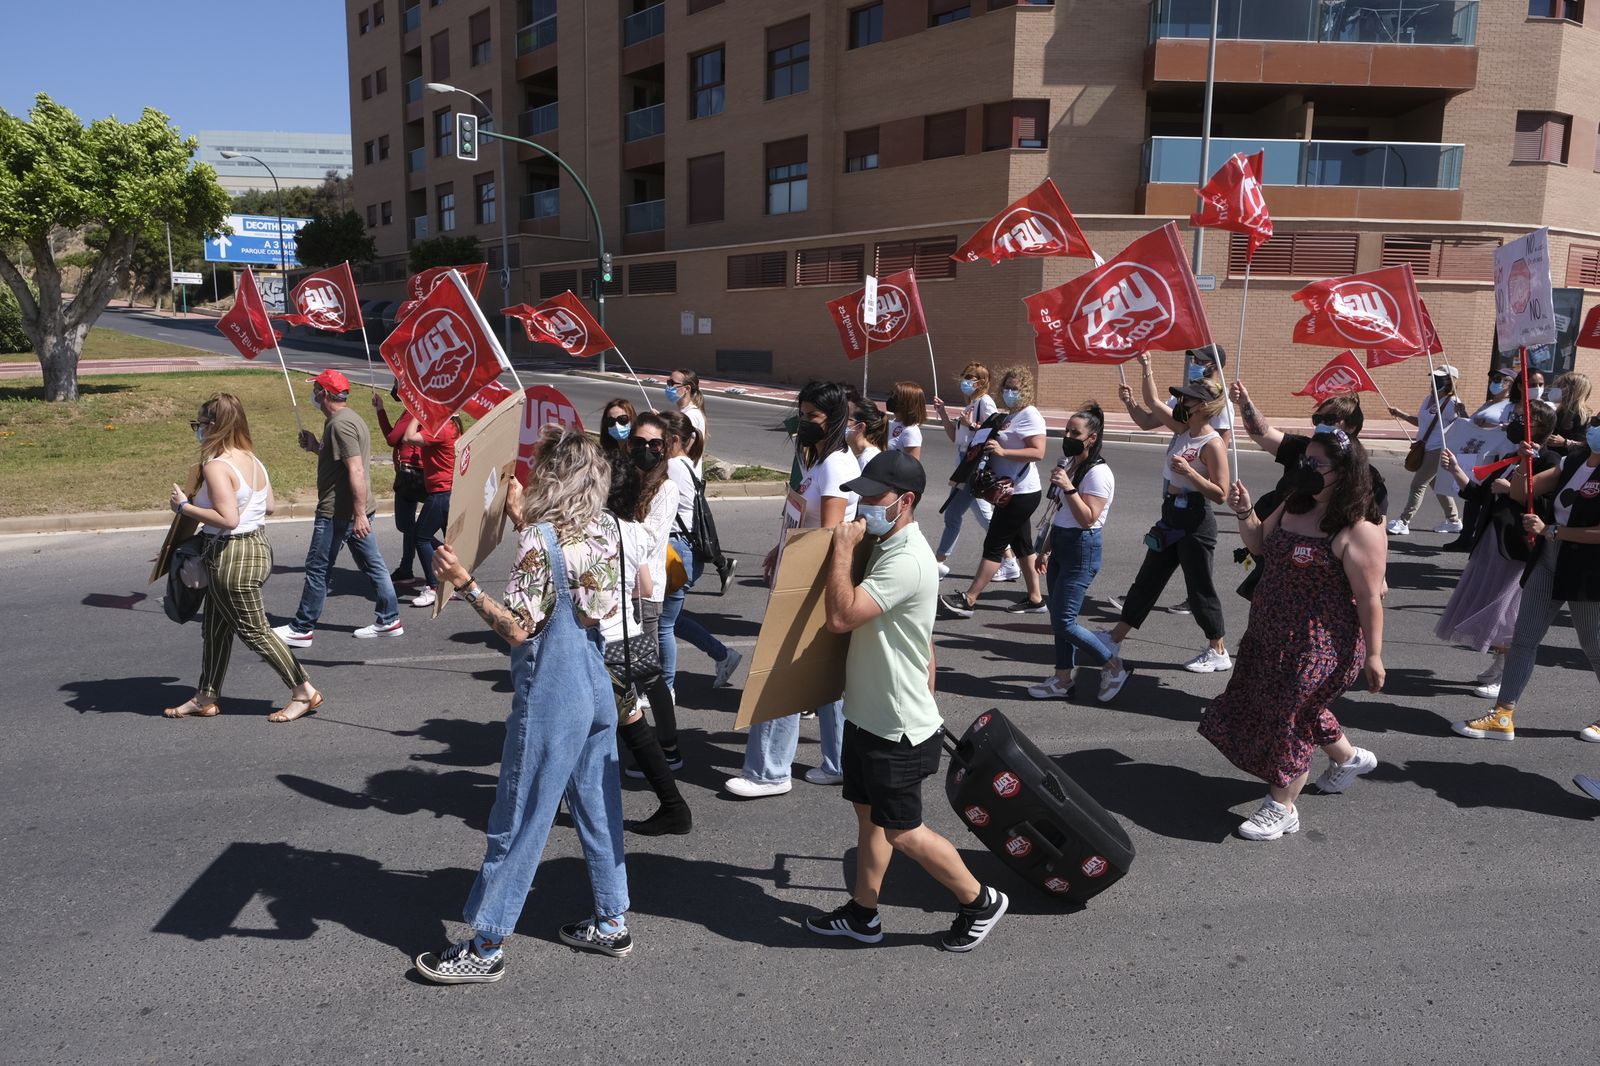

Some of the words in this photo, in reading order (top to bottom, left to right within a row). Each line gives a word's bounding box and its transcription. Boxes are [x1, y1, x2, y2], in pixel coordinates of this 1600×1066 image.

[241, 247, 266, 255] PARQUE
[264, 240, 271, 249] A
[273, 241, 279, 249] 3
[1525, 234, 1536, 256] NO
[1529, 298, 1541, 320] NO
[410, 315, 464, 377] UGT
[519, 398, 576, 445] UGT
[1294, 546, 1312, 556] UGT
[993, 773, 1014, 792] UGT
[965, 806, 984, 822] UGT
[1006, 836, 1025, 853] UGT
[1082, 856, 1102, 876] UGT
